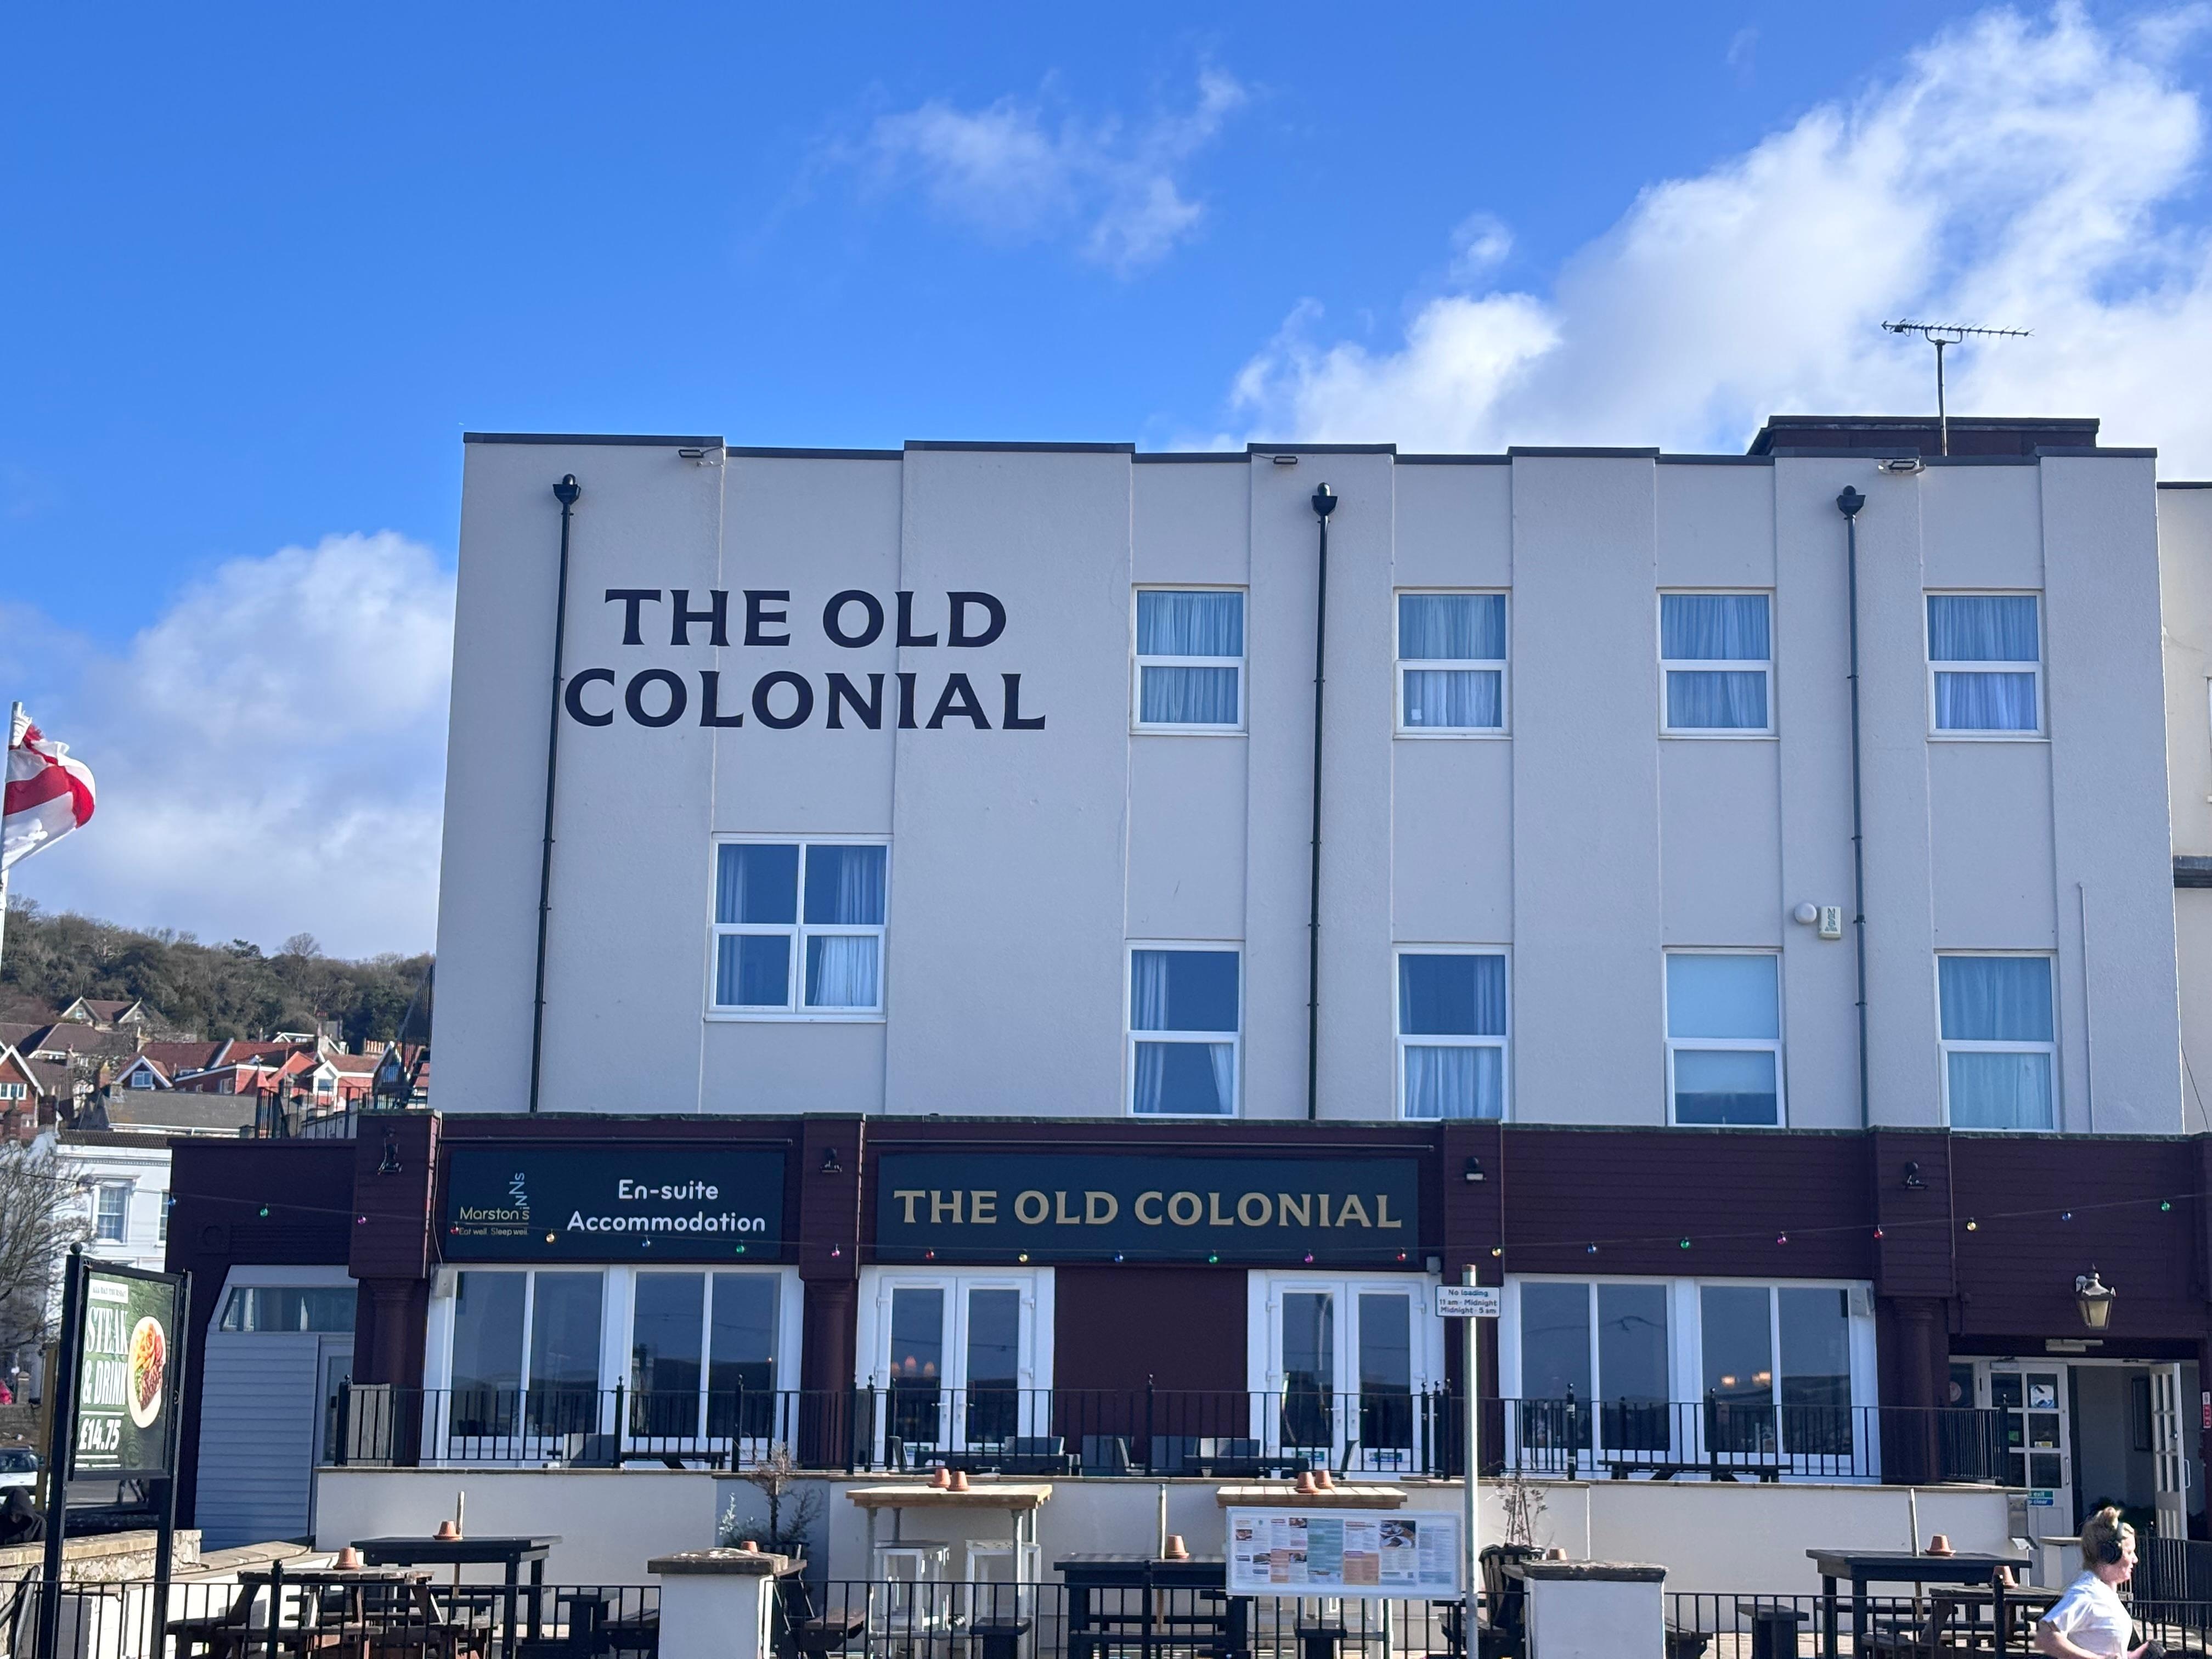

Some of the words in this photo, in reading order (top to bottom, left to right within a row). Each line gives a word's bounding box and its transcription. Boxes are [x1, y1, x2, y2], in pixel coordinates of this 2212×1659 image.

[604, 589, 791, 646] THE
[822, 589, 1007, 648] OLD
[564, 668, 1046, 730] COLONIAL
[618, 1179, 719, 1200] En-suite
[460, 1206, 530, 1220] Marston's
[567, 1210, 766, 1232] Accommodation
[893, 1189, 998, 1223] THE
[1014, 1189, 1119, 1225] OLD
[1133, 1190, 1402, 1228] COLONIAL
[1440, 1306, 1473, 1314] Midnight
[86, 1306, 128, 1355] STEAK
[82, 1359, 93, 1404] &
[93, 1360, 128, 1405] DRINK
[78, 1418, 122, 1450] £14.75
